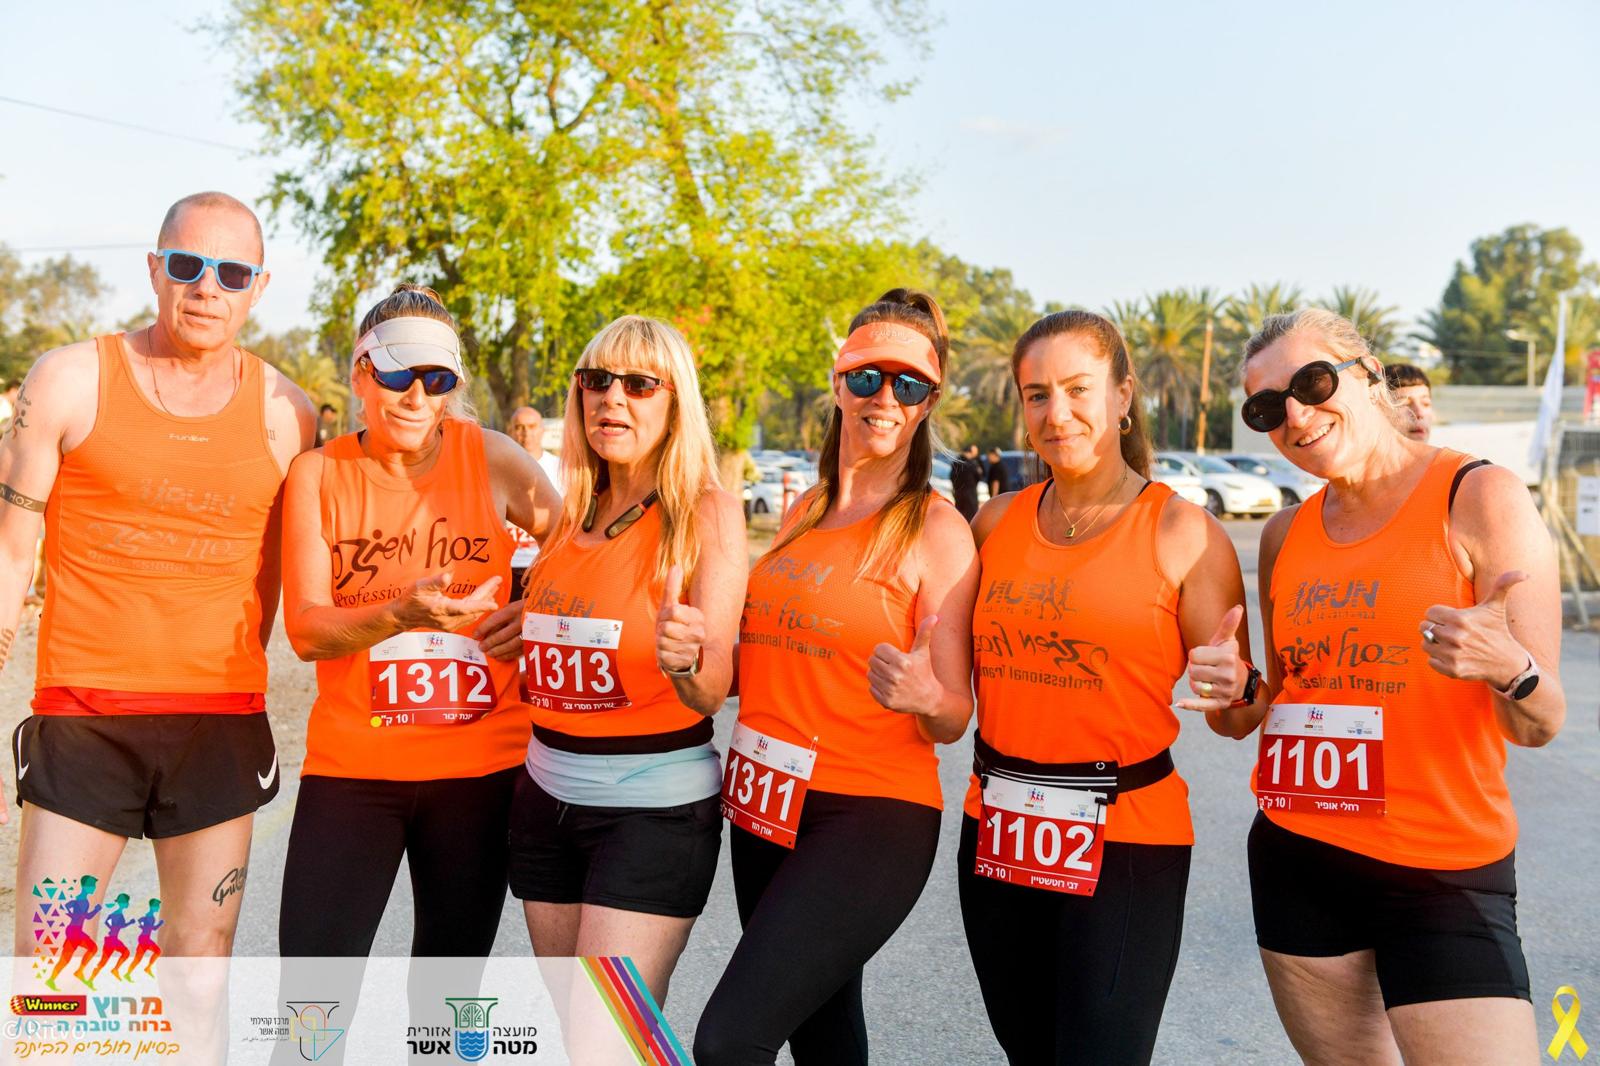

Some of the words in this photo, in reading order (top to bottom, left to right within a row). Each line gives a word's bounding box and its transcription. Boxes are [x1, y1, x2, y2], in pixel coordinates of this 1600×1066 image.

[424, 517, 490, 569] hoz
[1337, 627, 1411, 667] hoz
[378, 661, 492, 705] 1312
[528, 644, 615, 694] 1313
[395, 713, 408, 724] 10
[541, 697, 550, 708] 10
[1266, 738, 1369, 791] 1101
[728, 754, 797, 823] 1311
[1275, 796, 1286, 808] 10
[1314, 800, 1338, 810] אופיר
[986, 811, 1093, 872] 1102
[995, 867, 1006, 879] 10
